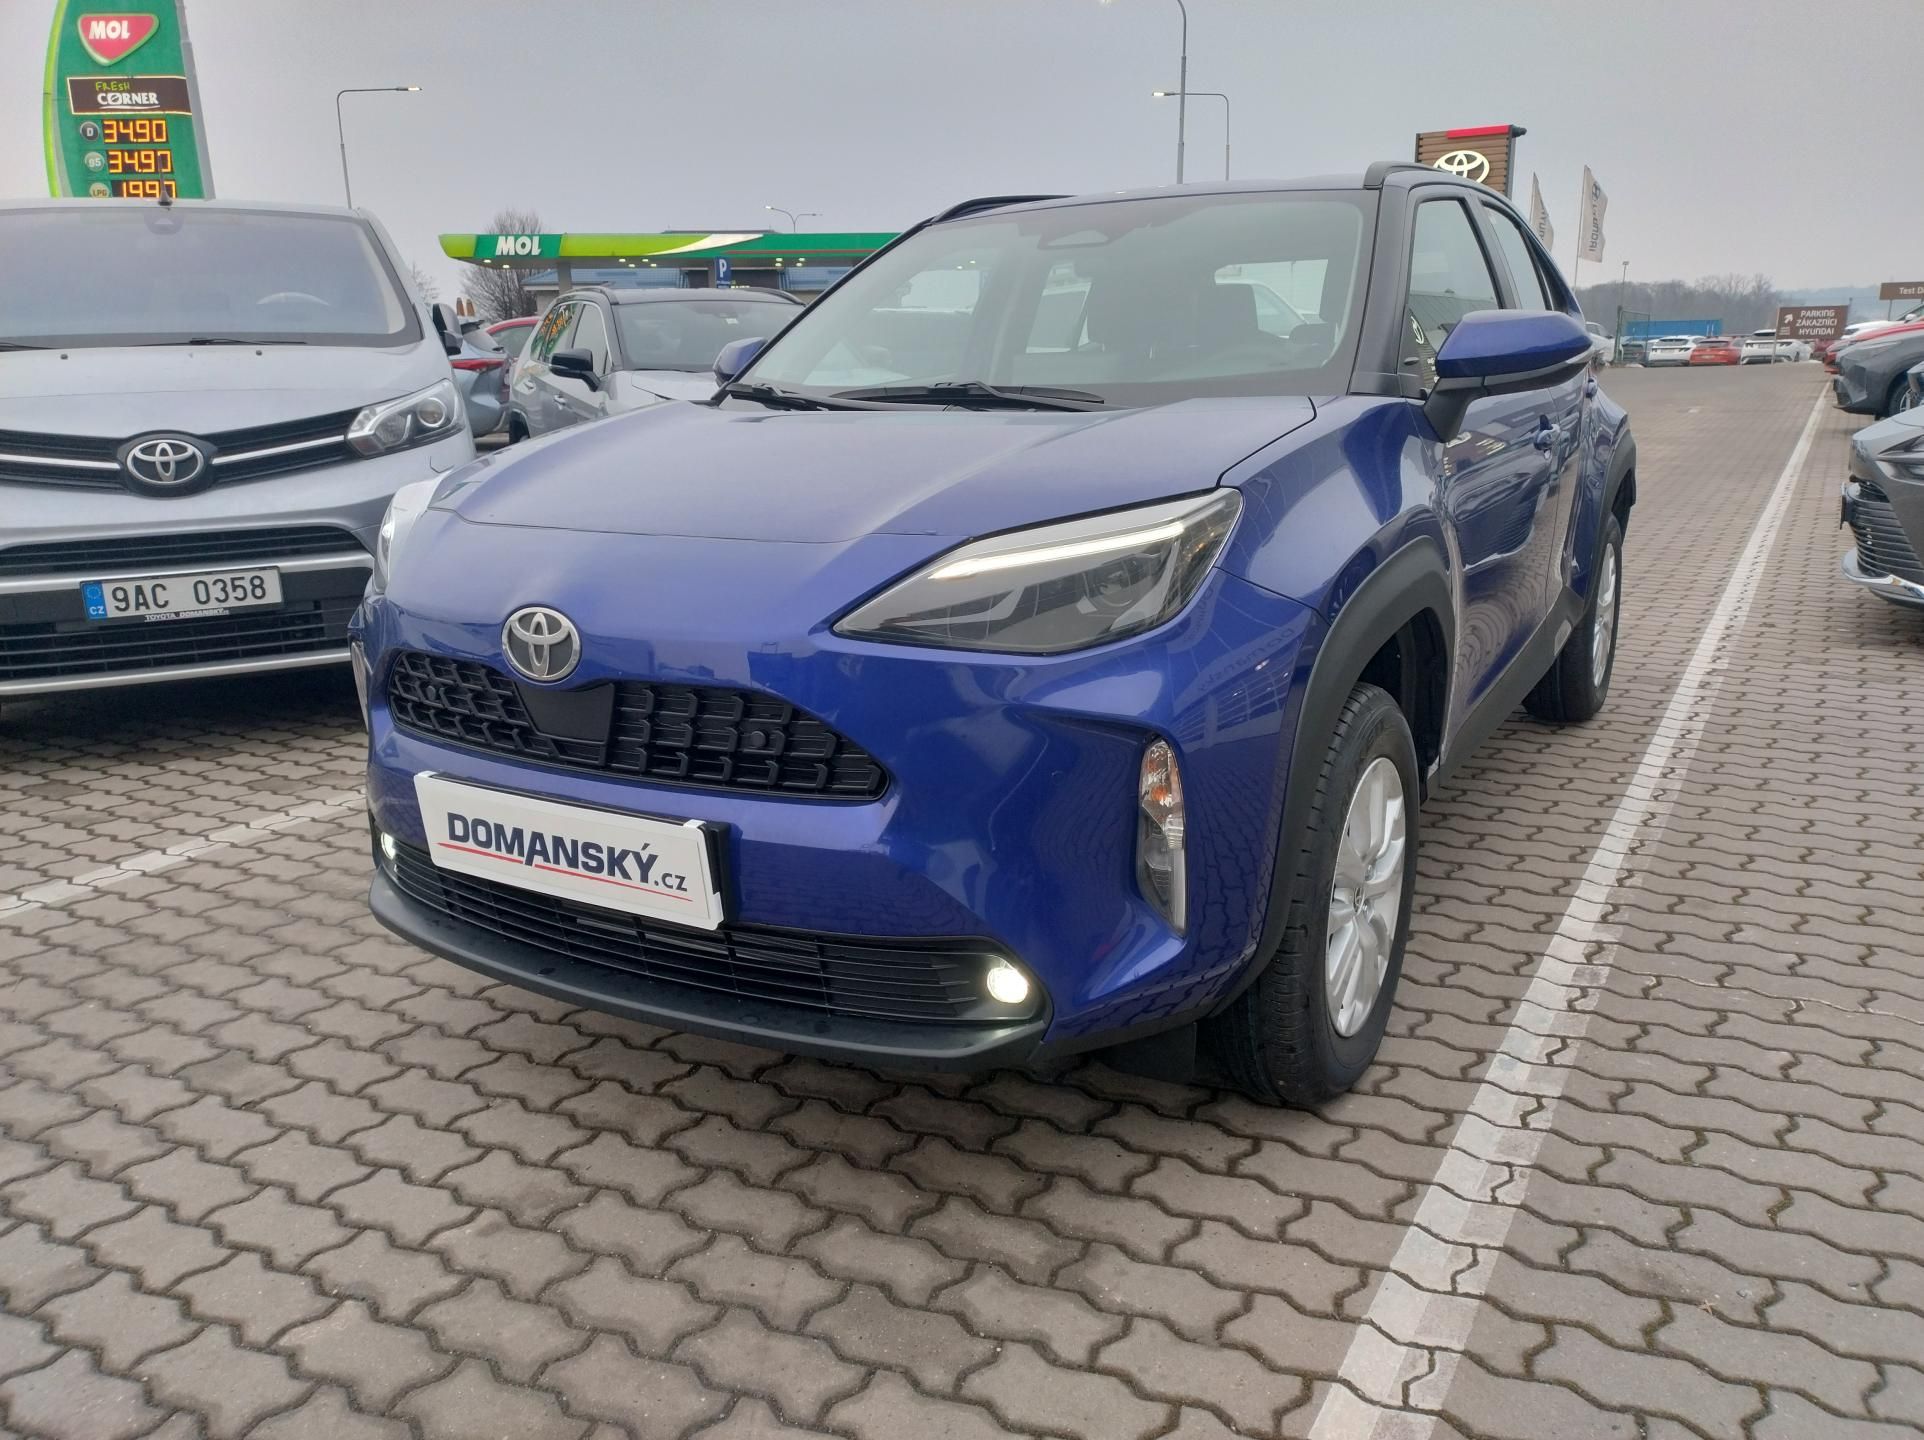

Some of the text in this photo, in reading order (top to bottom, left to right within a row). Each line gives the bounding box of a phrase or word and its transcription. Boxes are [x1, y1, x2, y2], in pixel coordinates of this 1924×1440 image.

[89, 20, 130, 39] MOL
[97, 92, 159, 105] CORNER
[86, 127, 94, 136] D
[88, 157, 101, 168] 95
[496, 235, 541, 256] MOL
[719, 258, 728, 278] P
[1800, 309, 1835, 317] PARKING
[111, 575, 267, 612] 9AC 0358
[89, 606, 105, 615] CZ
[144, 612, 176, 622] TOYOTA
